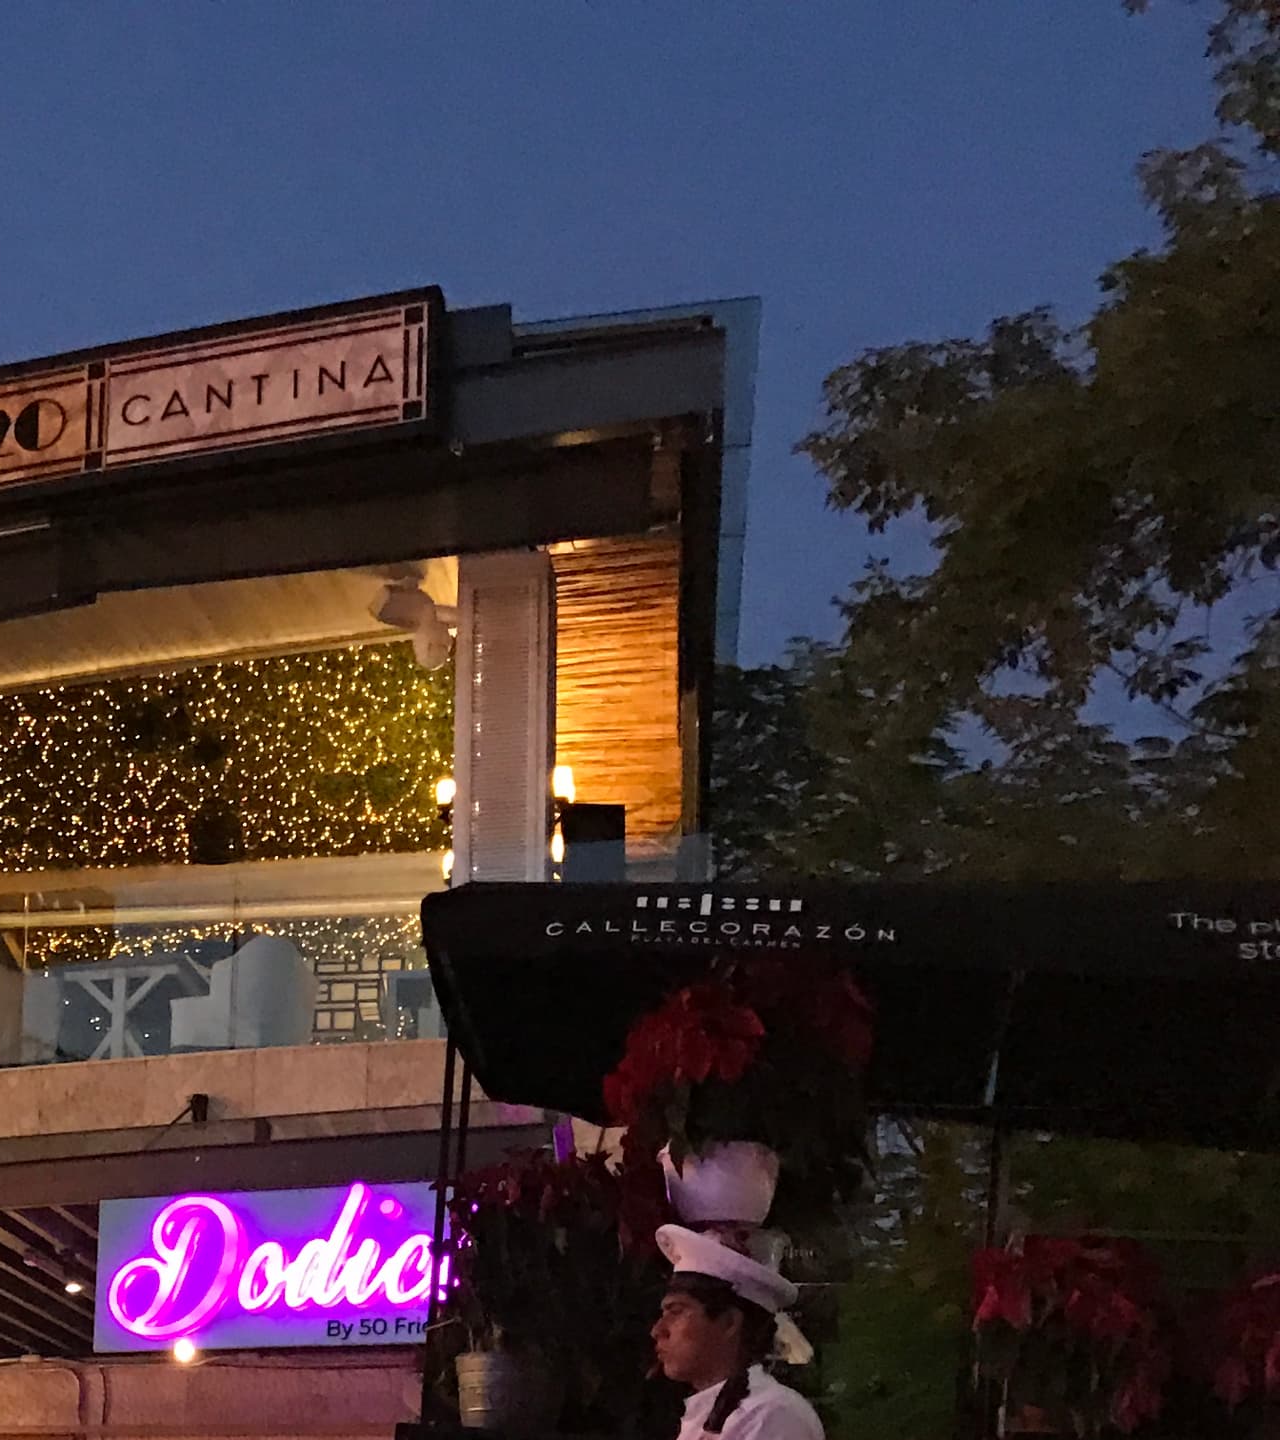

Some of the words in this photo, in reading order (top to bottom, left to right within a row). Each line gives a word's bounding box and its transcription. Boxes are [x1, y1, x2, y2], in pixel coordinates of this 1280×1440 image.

[120, 354, 396, 427] CANTINA
[1168, 912, 1237, 933] The
[327, 1320, 354, 1340] By
